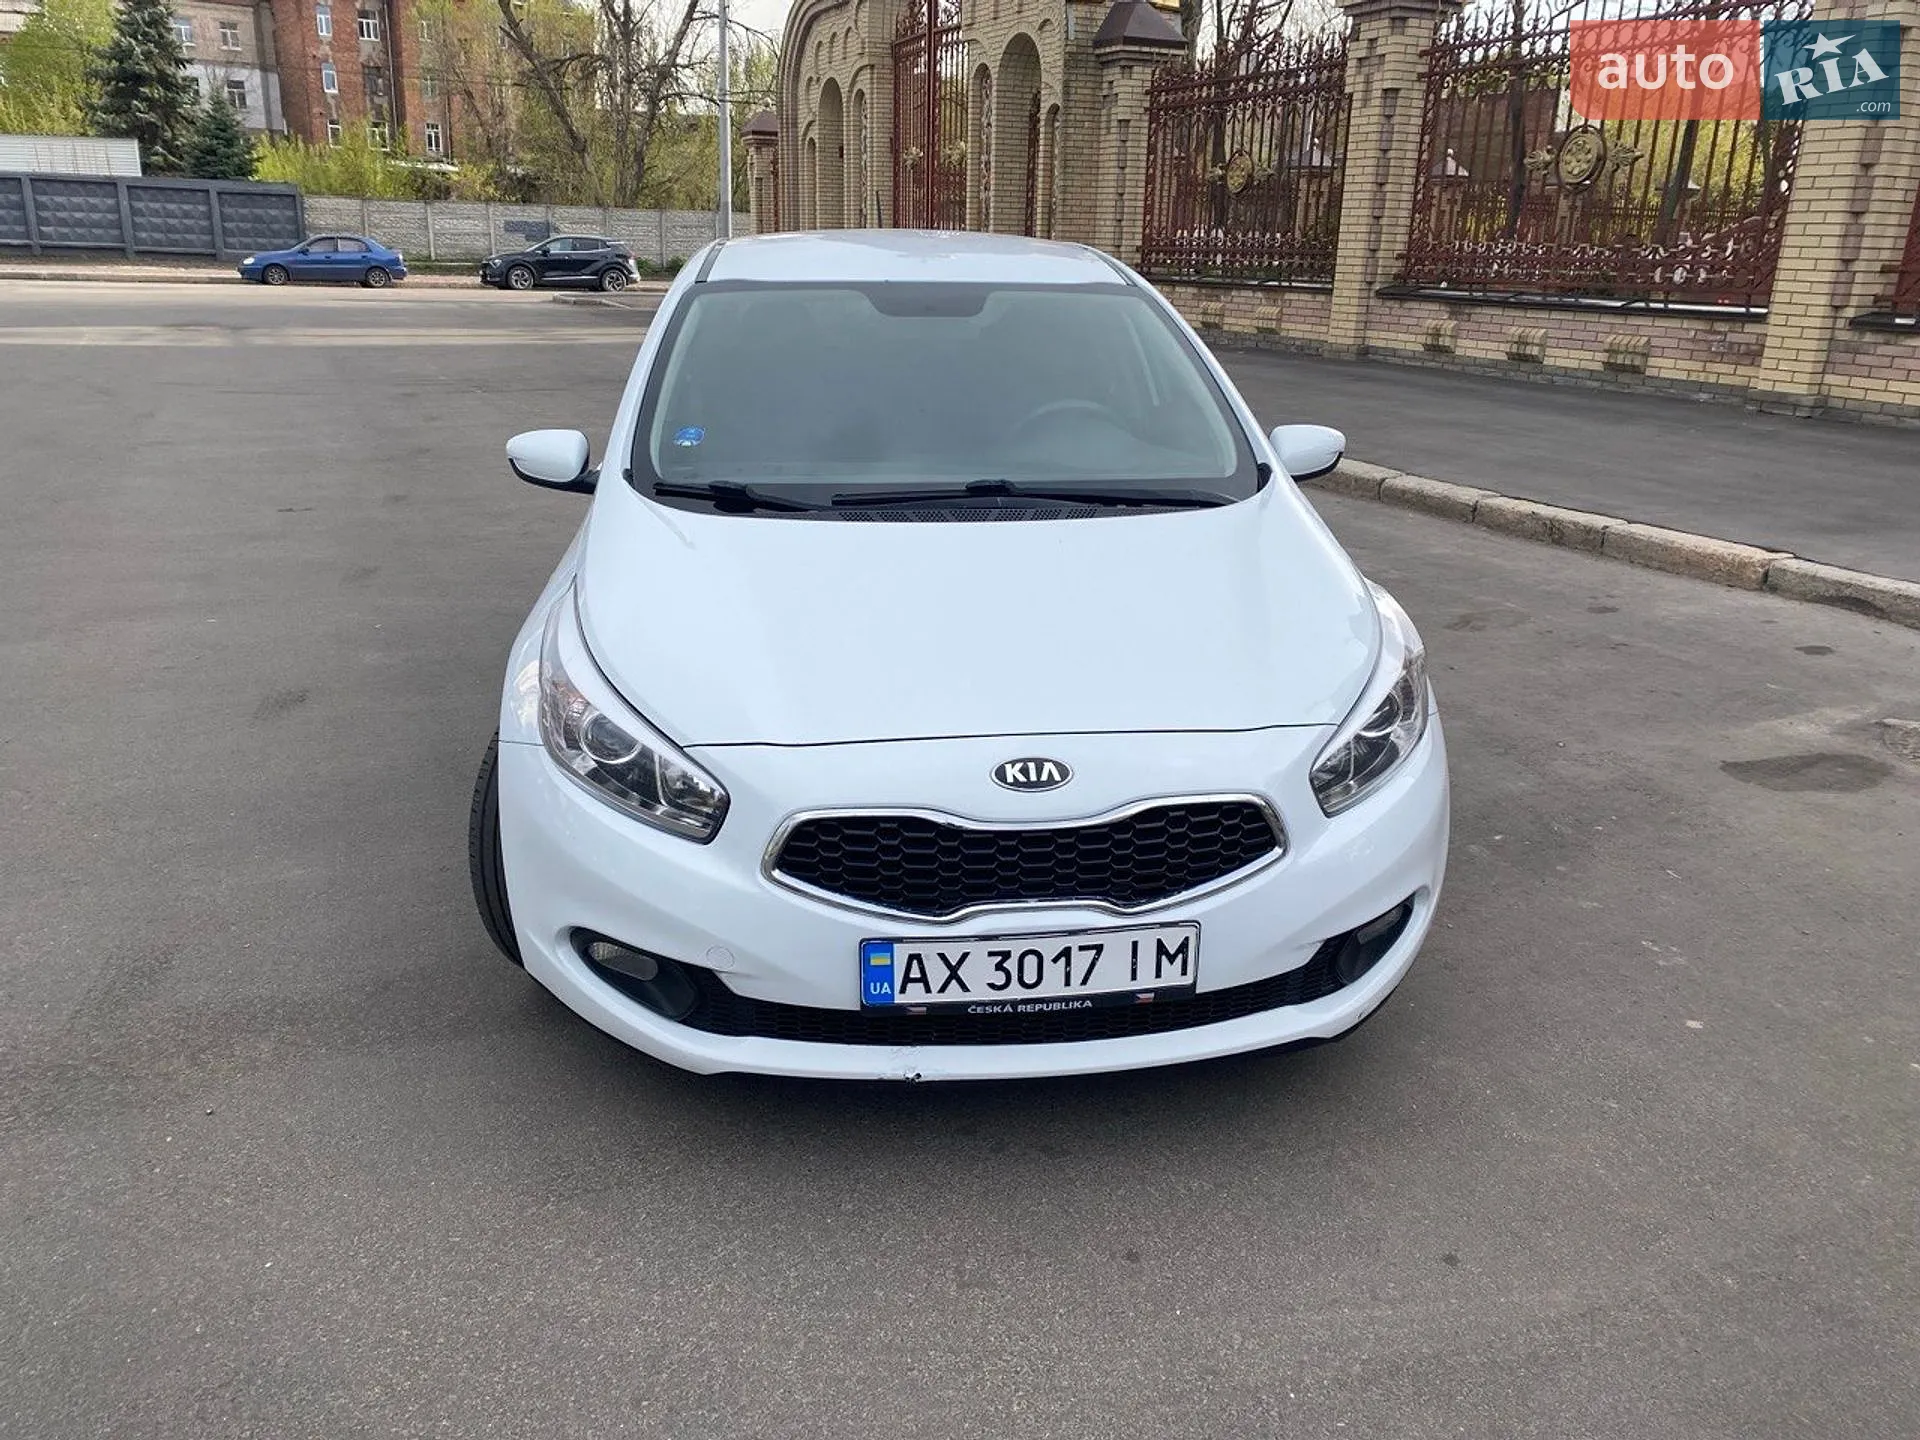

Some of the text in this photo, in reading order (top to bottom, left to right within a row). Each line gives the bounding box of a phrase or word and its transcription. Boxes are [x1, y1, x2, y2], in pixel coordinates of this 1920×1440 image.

[1004, 762, 1062, 783] KIA
[899, 936, 1190, 995] AX 3017 IM
[870, 982, 892, 995] UA
[1017, 1000, 1093, 1013] REPUBLIKA
